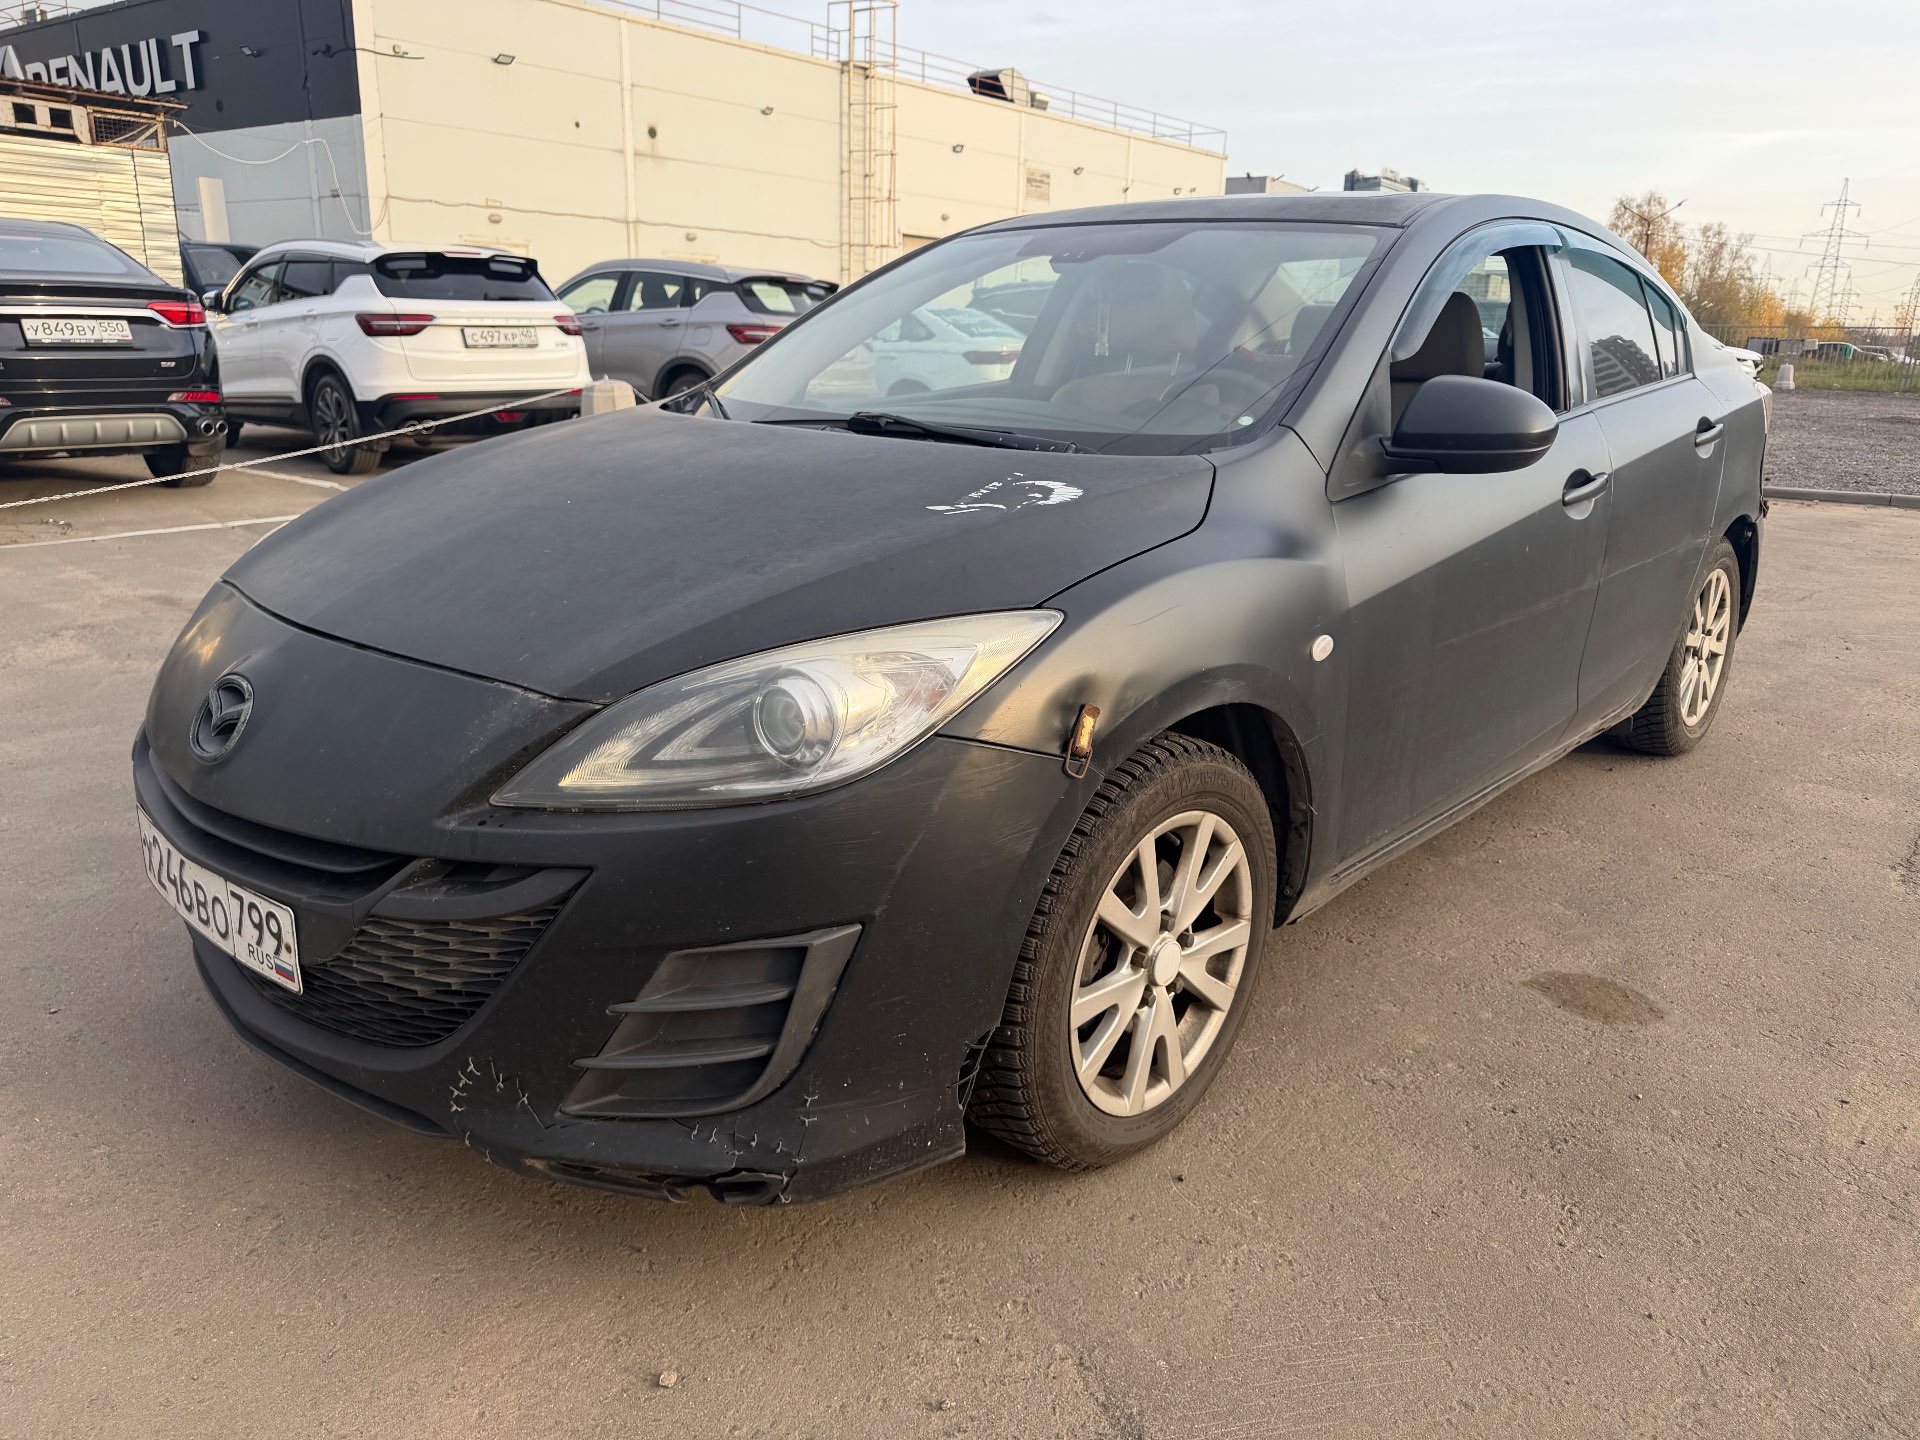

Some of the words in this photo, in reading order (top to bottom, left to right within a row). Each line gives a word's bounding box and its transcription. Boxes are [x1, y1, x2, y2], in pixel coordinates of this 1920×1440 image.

[99, 322, 124, 333] 550
[230, 889, 284, 956] 799
[248, 943, 274, 970] RUS
